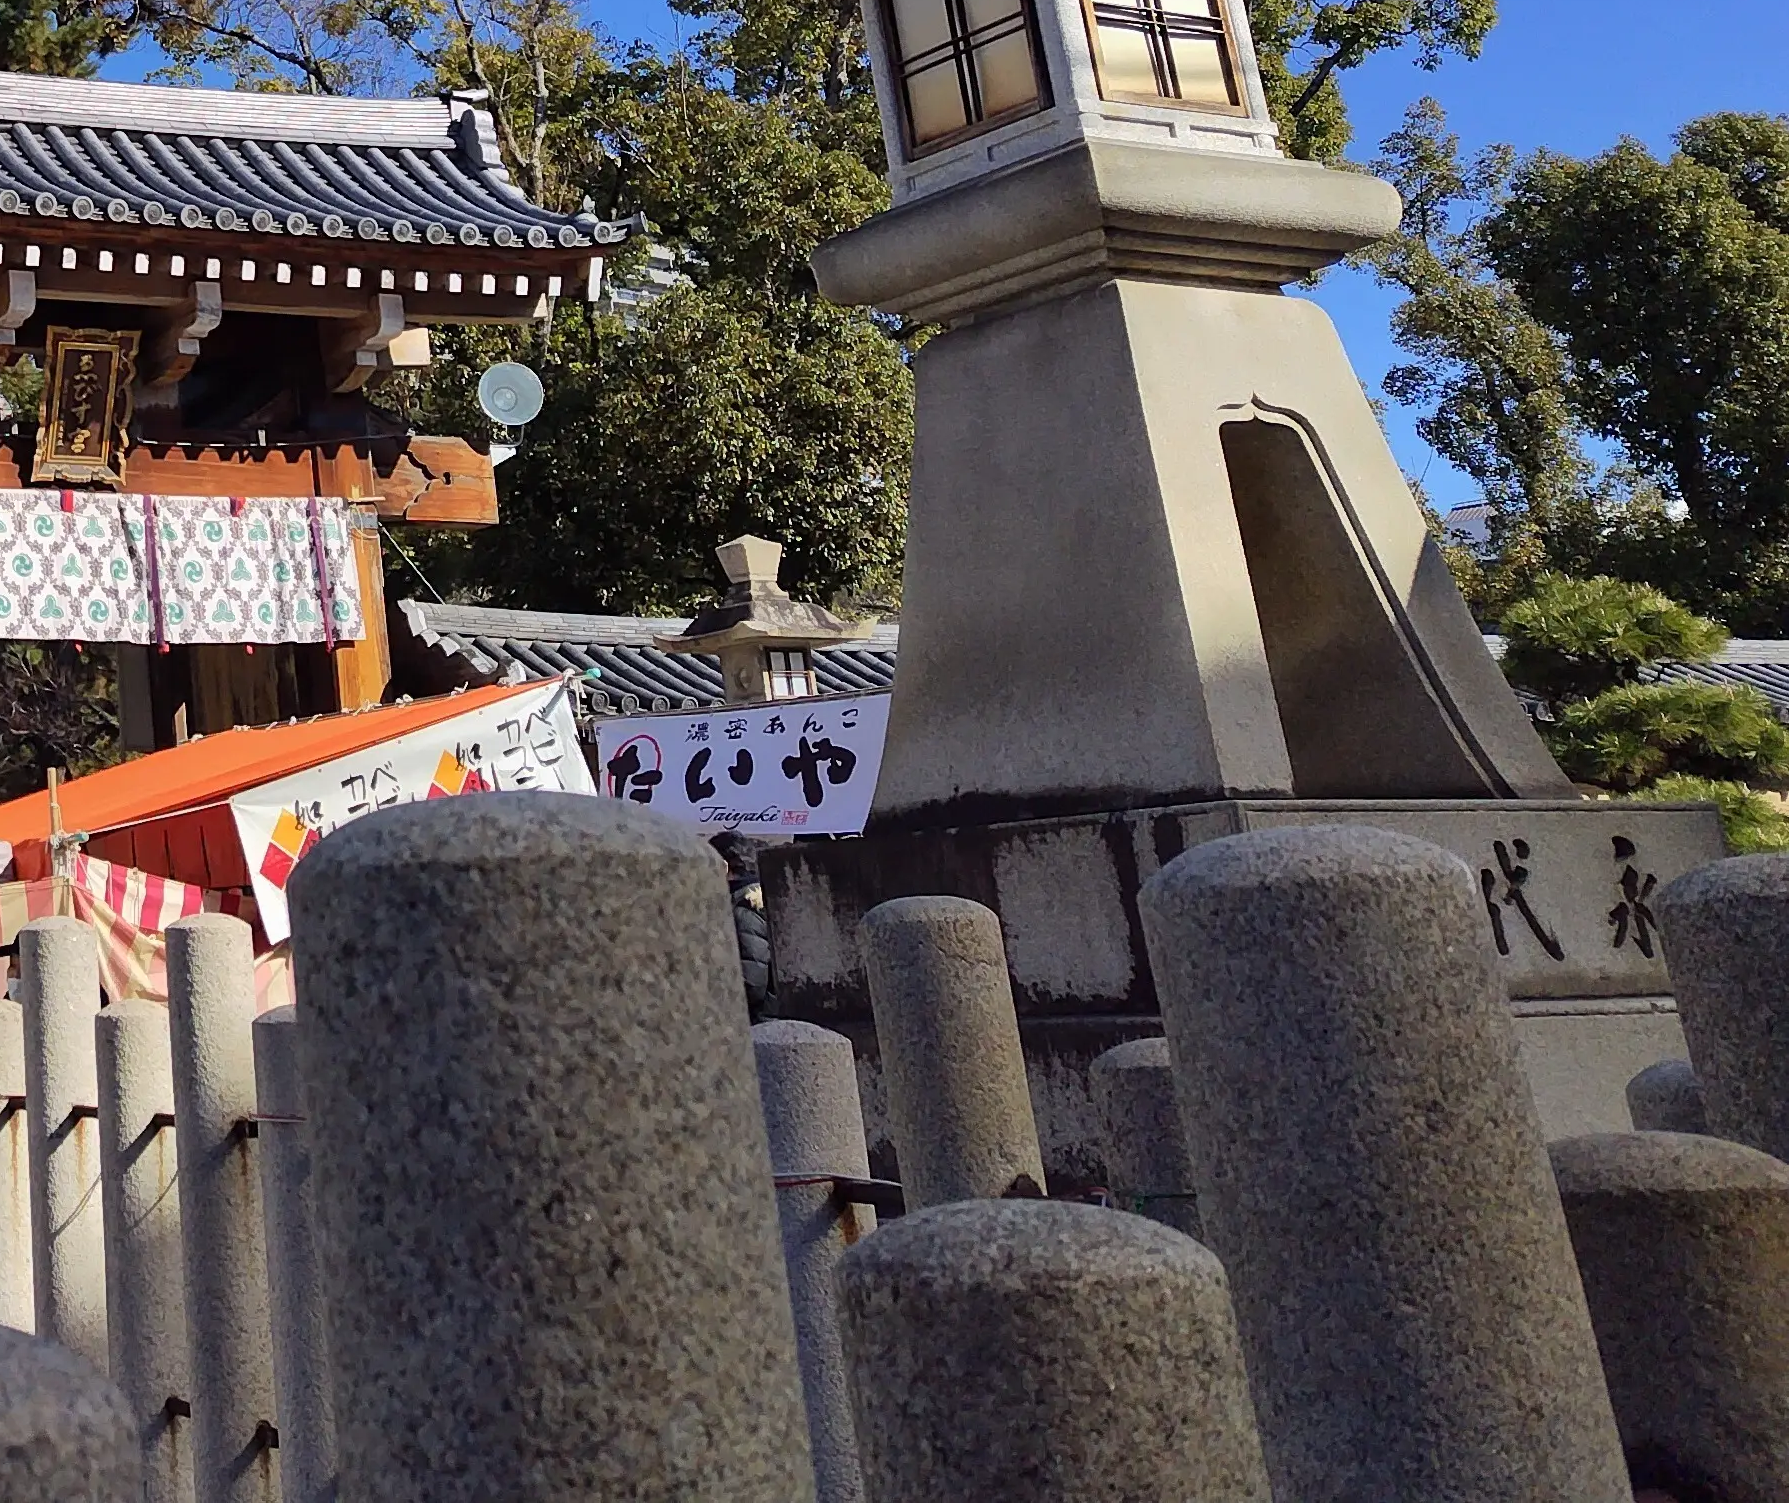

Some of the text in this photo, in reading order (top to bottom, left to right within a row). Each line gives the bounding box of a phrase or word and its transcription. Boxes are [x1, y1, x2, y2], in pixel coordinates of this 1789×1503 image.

[685, 708, 859, 742] 濃密あんこ
[699, 805, 781, 830] Taiyaki
